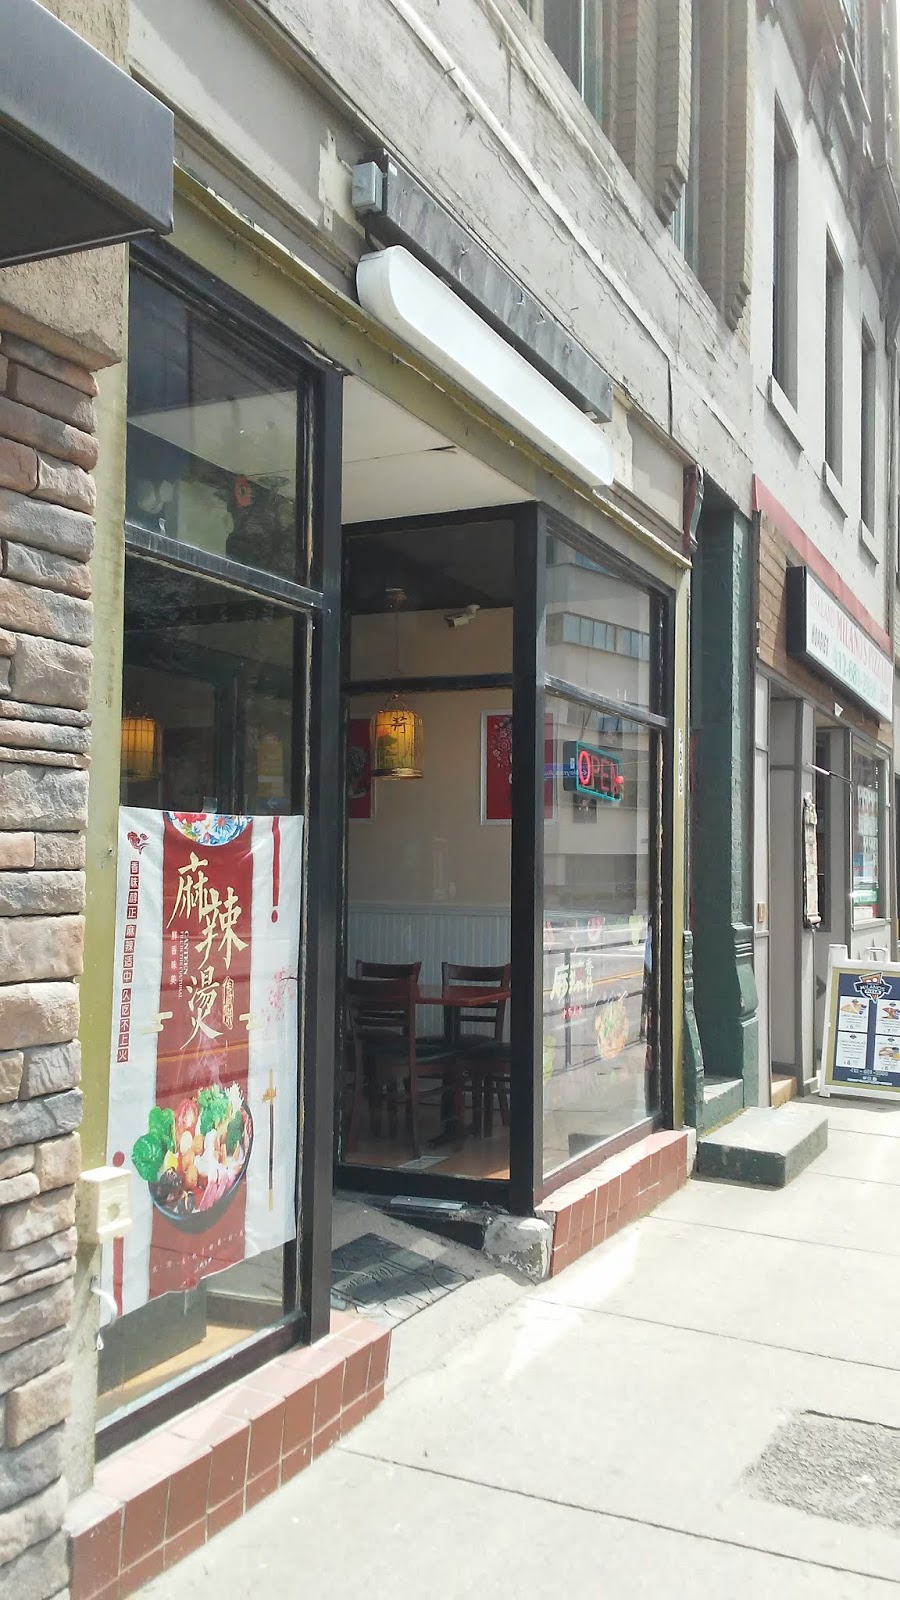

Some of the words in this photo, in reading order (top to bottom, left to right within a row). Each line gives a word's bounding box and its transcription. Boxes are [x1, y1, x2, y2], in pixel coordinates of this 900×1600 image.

[578, 749, 619, 796] OPEN
[117, 988, 132, 1063] 久吃不上火
